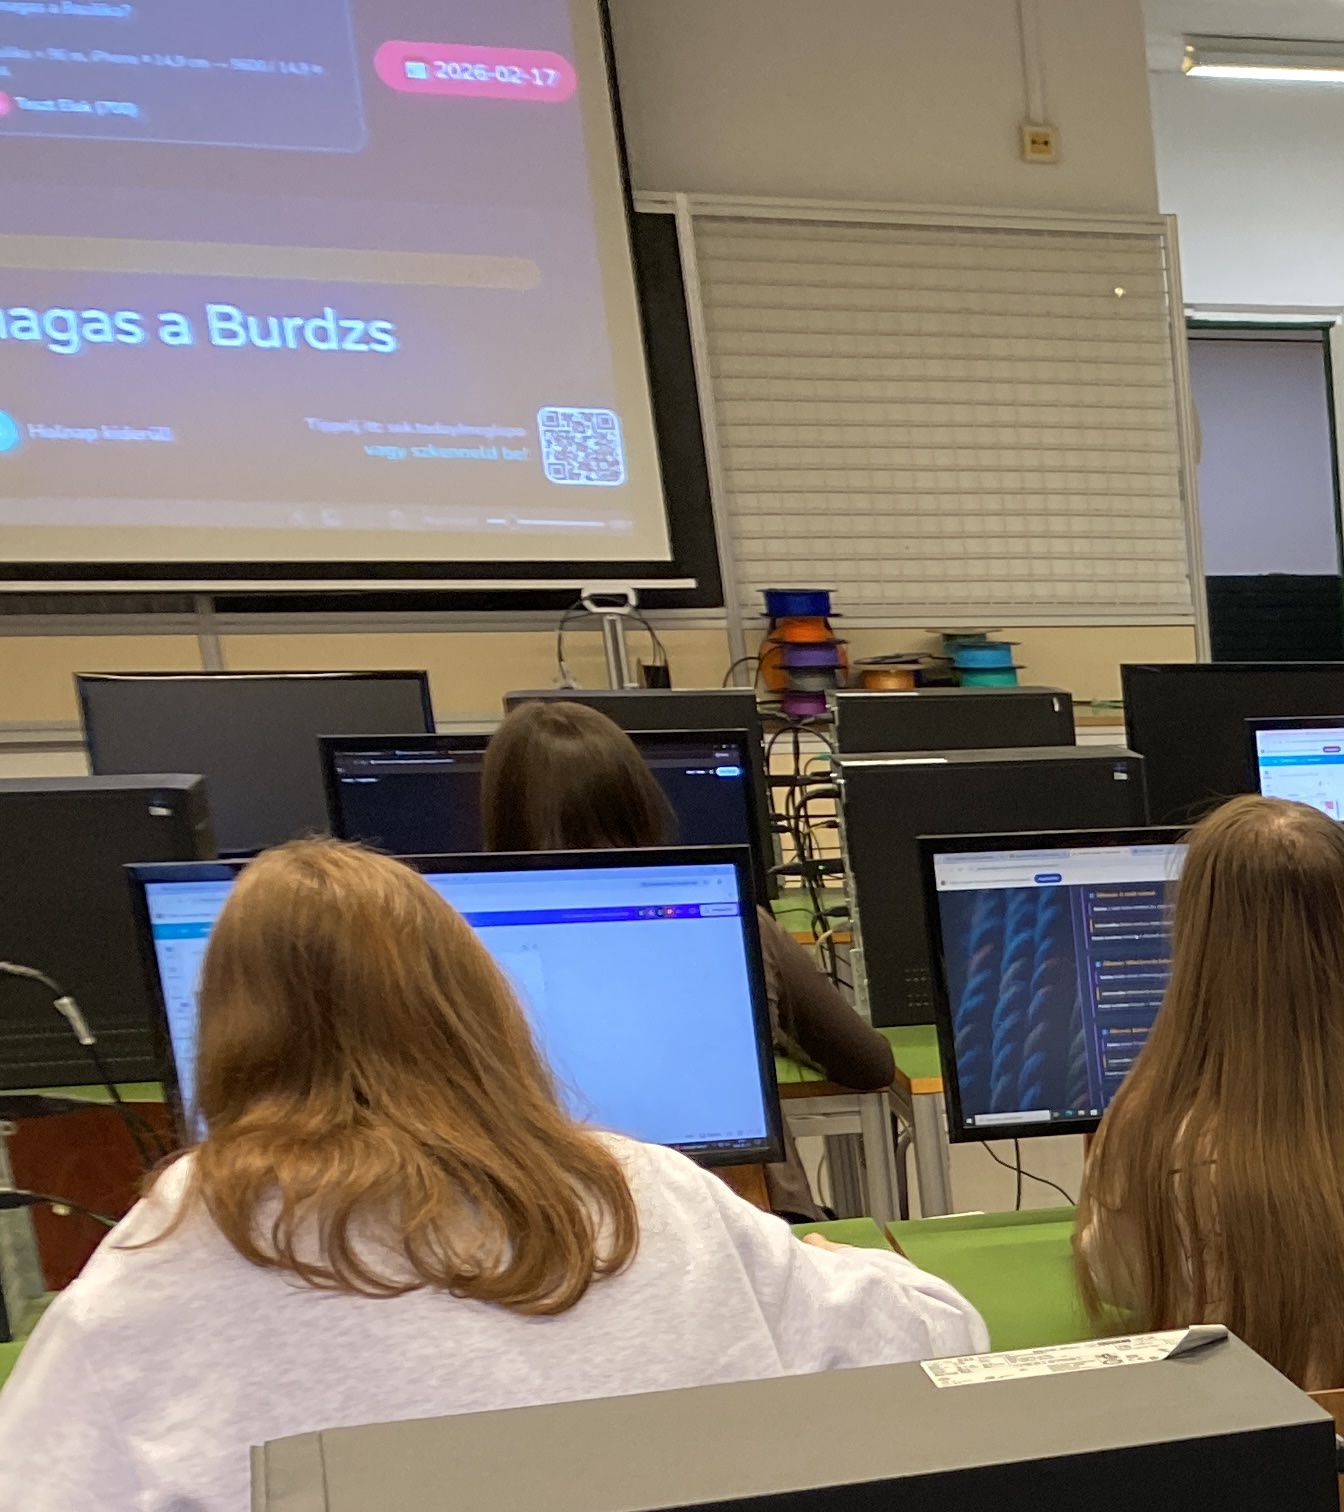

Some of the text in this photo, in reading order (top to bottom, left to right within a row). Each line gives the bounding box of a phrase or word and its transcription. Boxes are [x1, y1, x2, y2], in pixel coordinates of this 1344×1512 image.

[433, 60, 559, 87] 2026-02-17
[0, 303, 399, 355] agas a Burdzs
